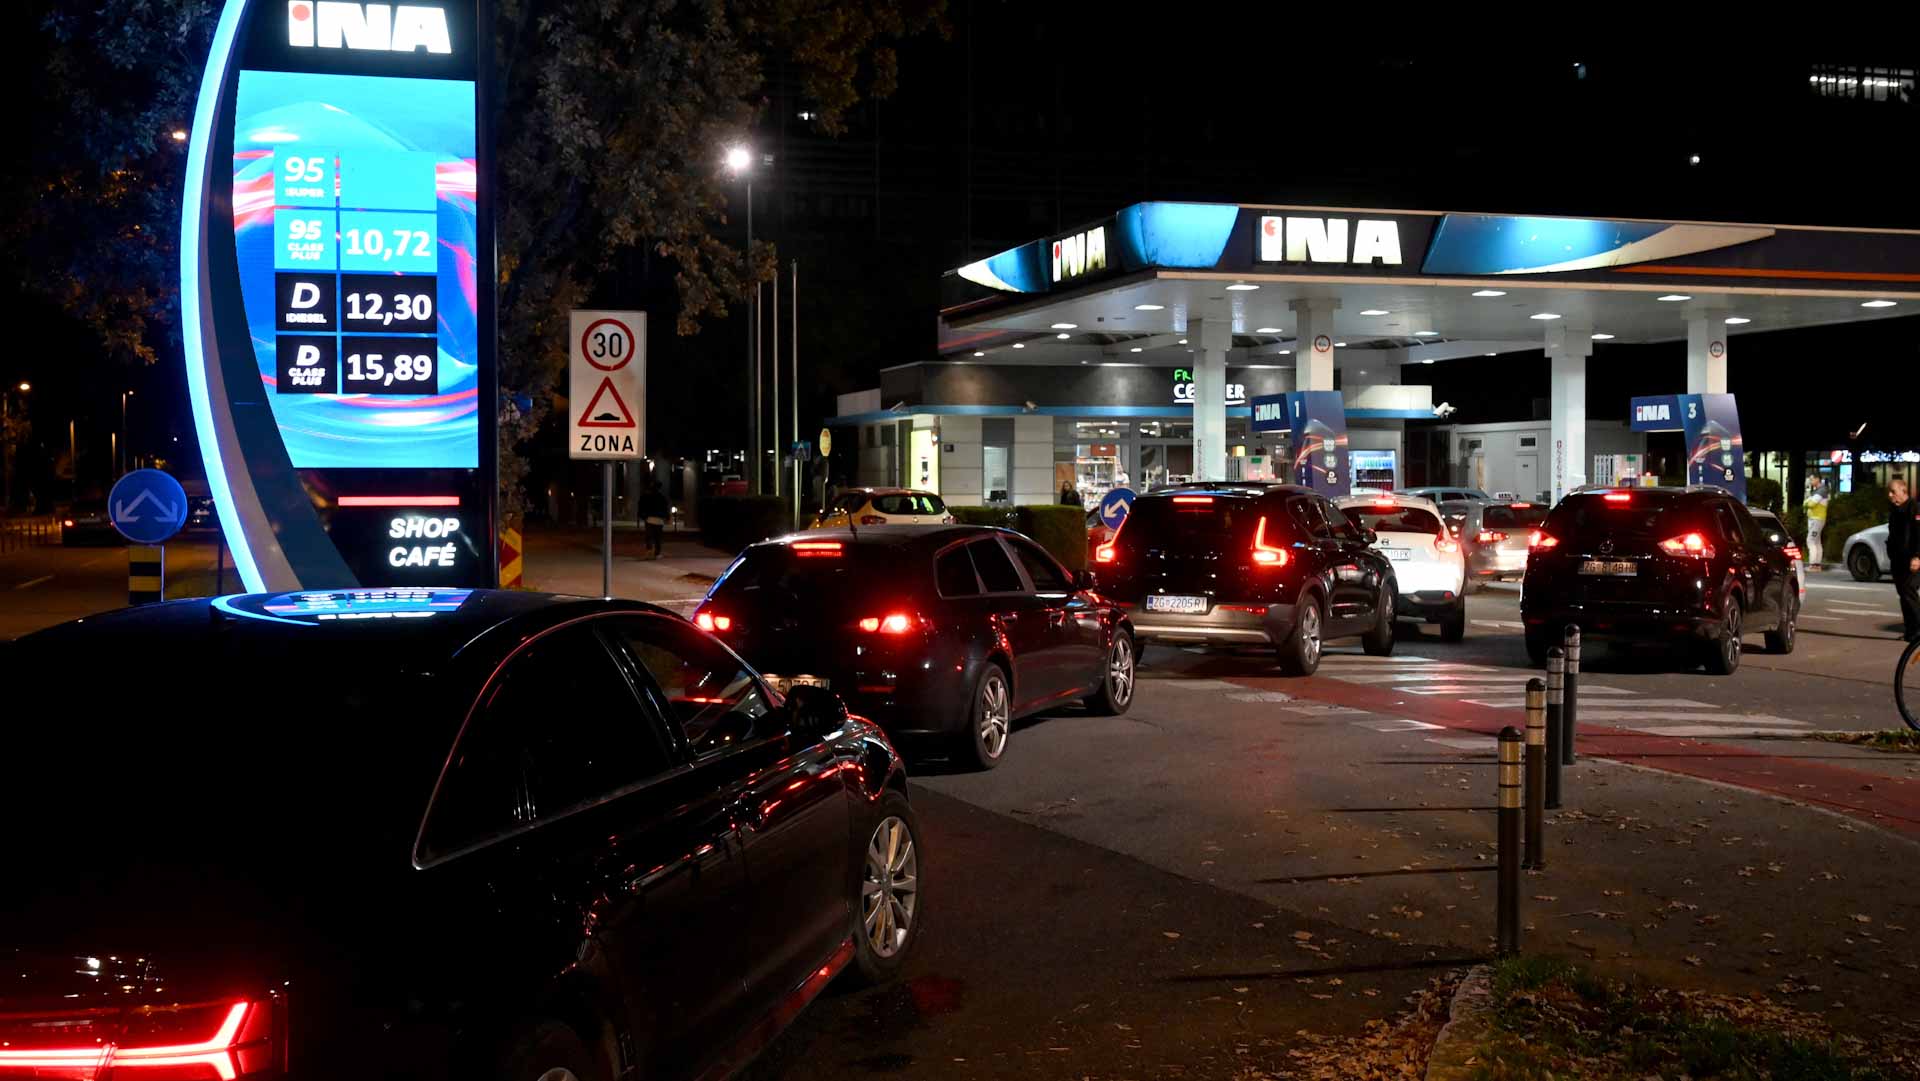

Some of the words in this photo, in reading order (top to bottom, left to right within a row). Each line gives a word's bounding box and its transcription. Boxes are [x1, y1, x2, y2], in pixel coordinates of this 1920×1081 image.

[284, 156, 325, 182] 95
[288, 219, 323, 240] 95
[287, 242, 324, 252] CLASS
[346, 228, 431, 261] 10,72
[290, 251, 321, 260] PLUS
[291, 282, 321, 309] D
[346, 293, 432, 326] 12,30
[296, 344, 320, 366] D
[593, 332, 622, 358] 30
[288, 367, 326, 378] CLASS
[347, 353, 433, 386] 15,89
[292, 376, 322, 386] PLUS
[1294, 400, 1300, 418] 1
[1688, 402, 1696, 419] 3
[581, 434, 634, 452] ZONA
[389, 517, 460, 538] SHOP
[389, 542, 457, 567] CAFÉ
